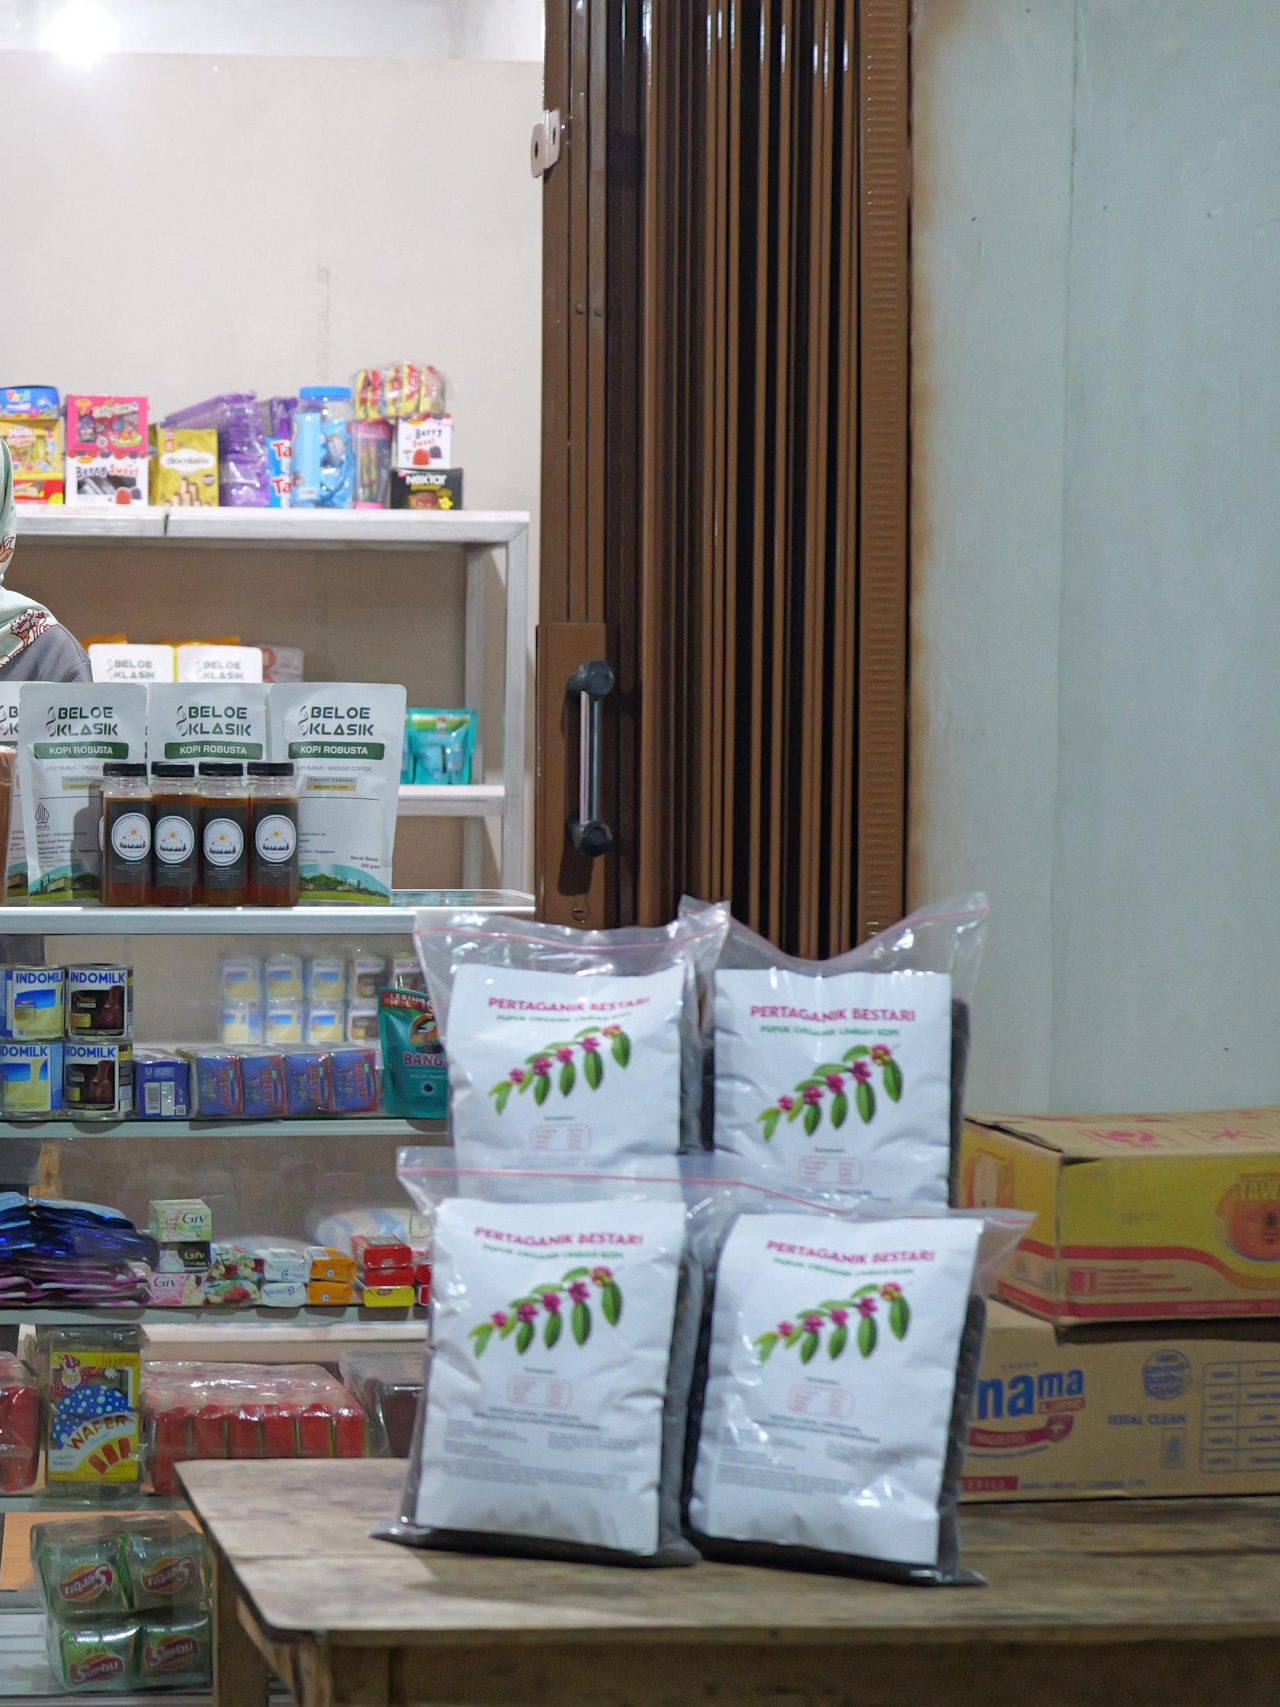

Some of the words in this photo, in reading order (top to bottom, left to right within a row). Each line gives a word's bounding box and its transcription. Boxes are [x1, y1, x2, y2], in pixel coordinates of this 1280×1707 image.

[114, 659, 152, 669] BELOE
[203, 661, 241, 669] BELOE
[113, 671, 156, 679] KLASIK
[202, 672, 244, 680] KLASIK
[58, 706, 113, 719] BELOE
[188, 705, 248, 719] BELOE
[311, 706, 371, 719] BELOE
[57, 722, 118, 737] KLASIK
[188, 722, 251, 736] KLASIK
[309, 722, 374, 736] KLASIK
[73, 746, 113, 755] ROBUSTA
[203, 745, 247, 755] ROBUSTA
[300, 746, 321, 754] KOPI
[323, 746, 368, 755] ROBUSTA
[70, 971, 125, 984] INDOMILK
[488, 997, 584, 1011] PERTAGANIK
[750, 1005, 847, 1022] PERTAGANIK
[852, 1008, 916, 1022] BESTARI
[0, 1045, 48, 1057] DOMILK
[66, 1046, 116, 1058] DOMILK
[403, 1052, 448, 1066] BANG
[474, 1226, 573, 1246] PERTAGANIK
[578, 1232, 644, 1246] BESTARI
[766, 1240, 867, 1264] PERTAGANIK
[872, 1250, 936, 1263] BESTARI
[66, 1413, 128, 1450] WAFER
